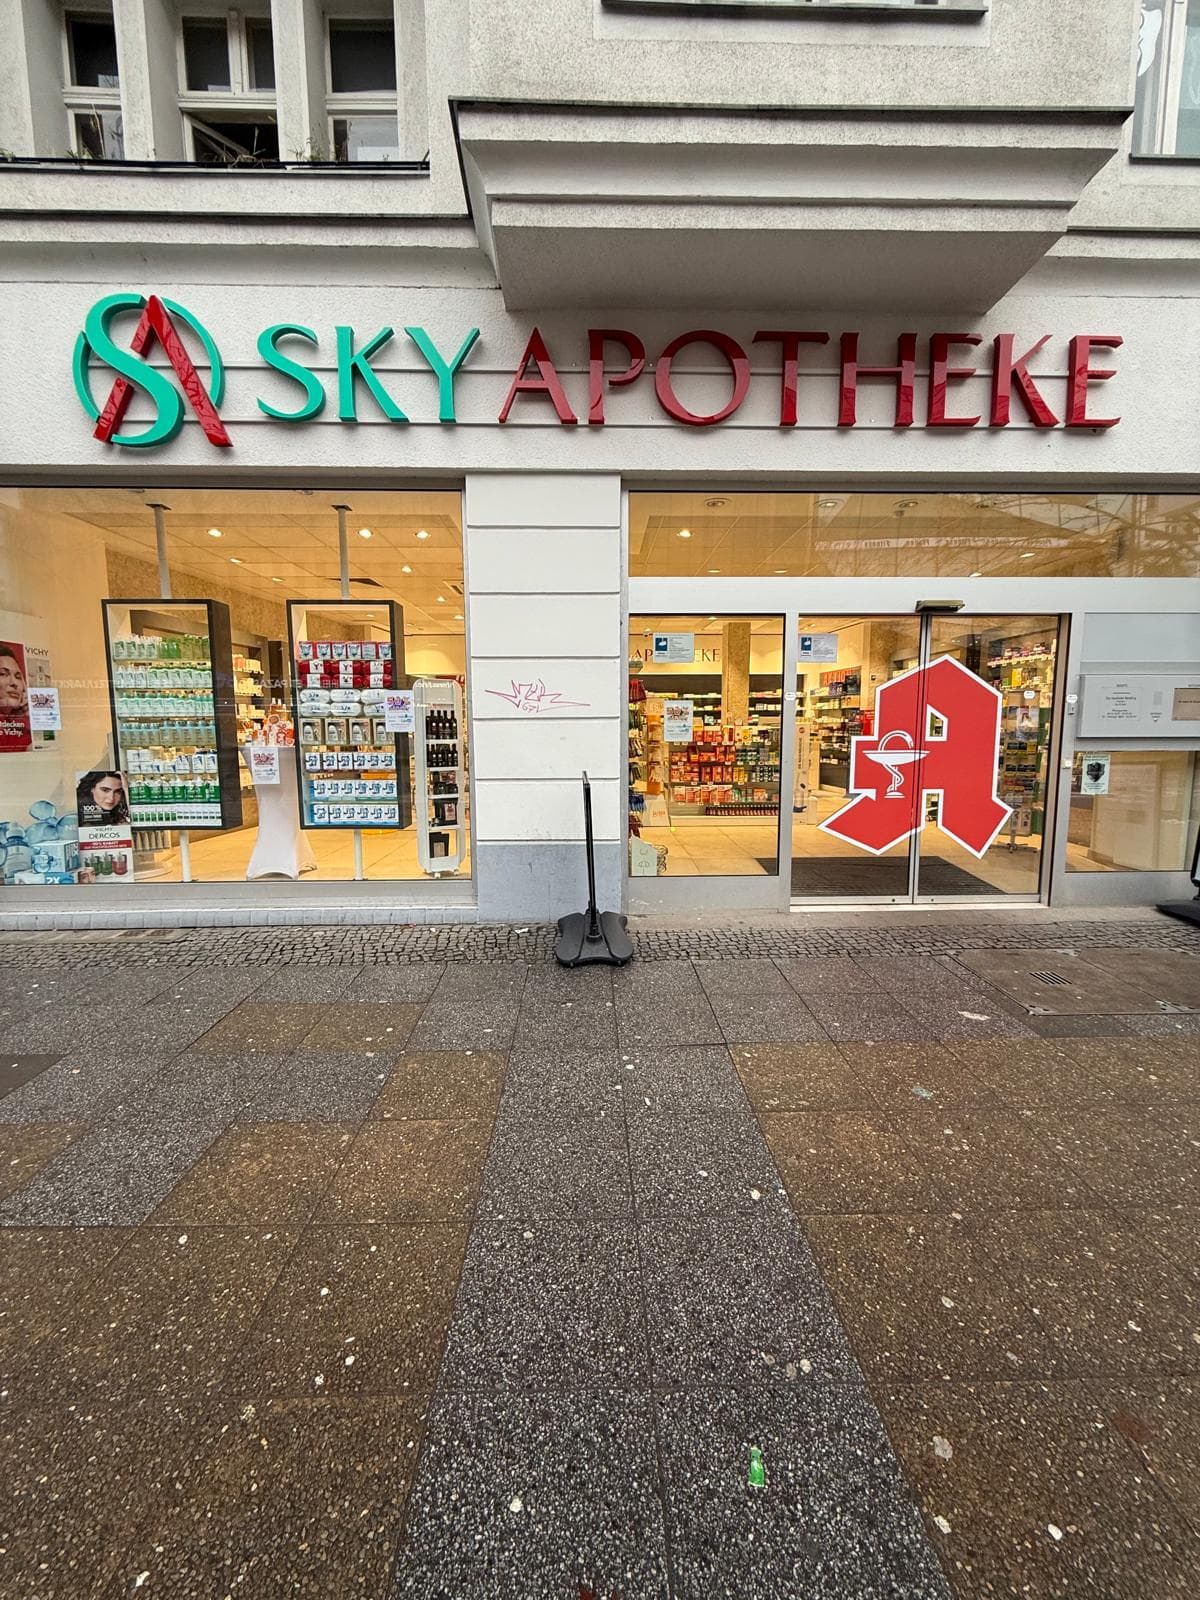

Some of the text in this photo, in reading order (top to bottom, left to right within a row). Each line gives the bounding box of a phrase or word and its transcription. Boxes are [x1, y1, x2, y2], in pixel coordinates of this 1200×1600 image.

[256, 323, 1124, 429] SKY APOTHEKE
[25, 647, 49, 657] VICHY
[88, 832, 121, 840] DERCOS
